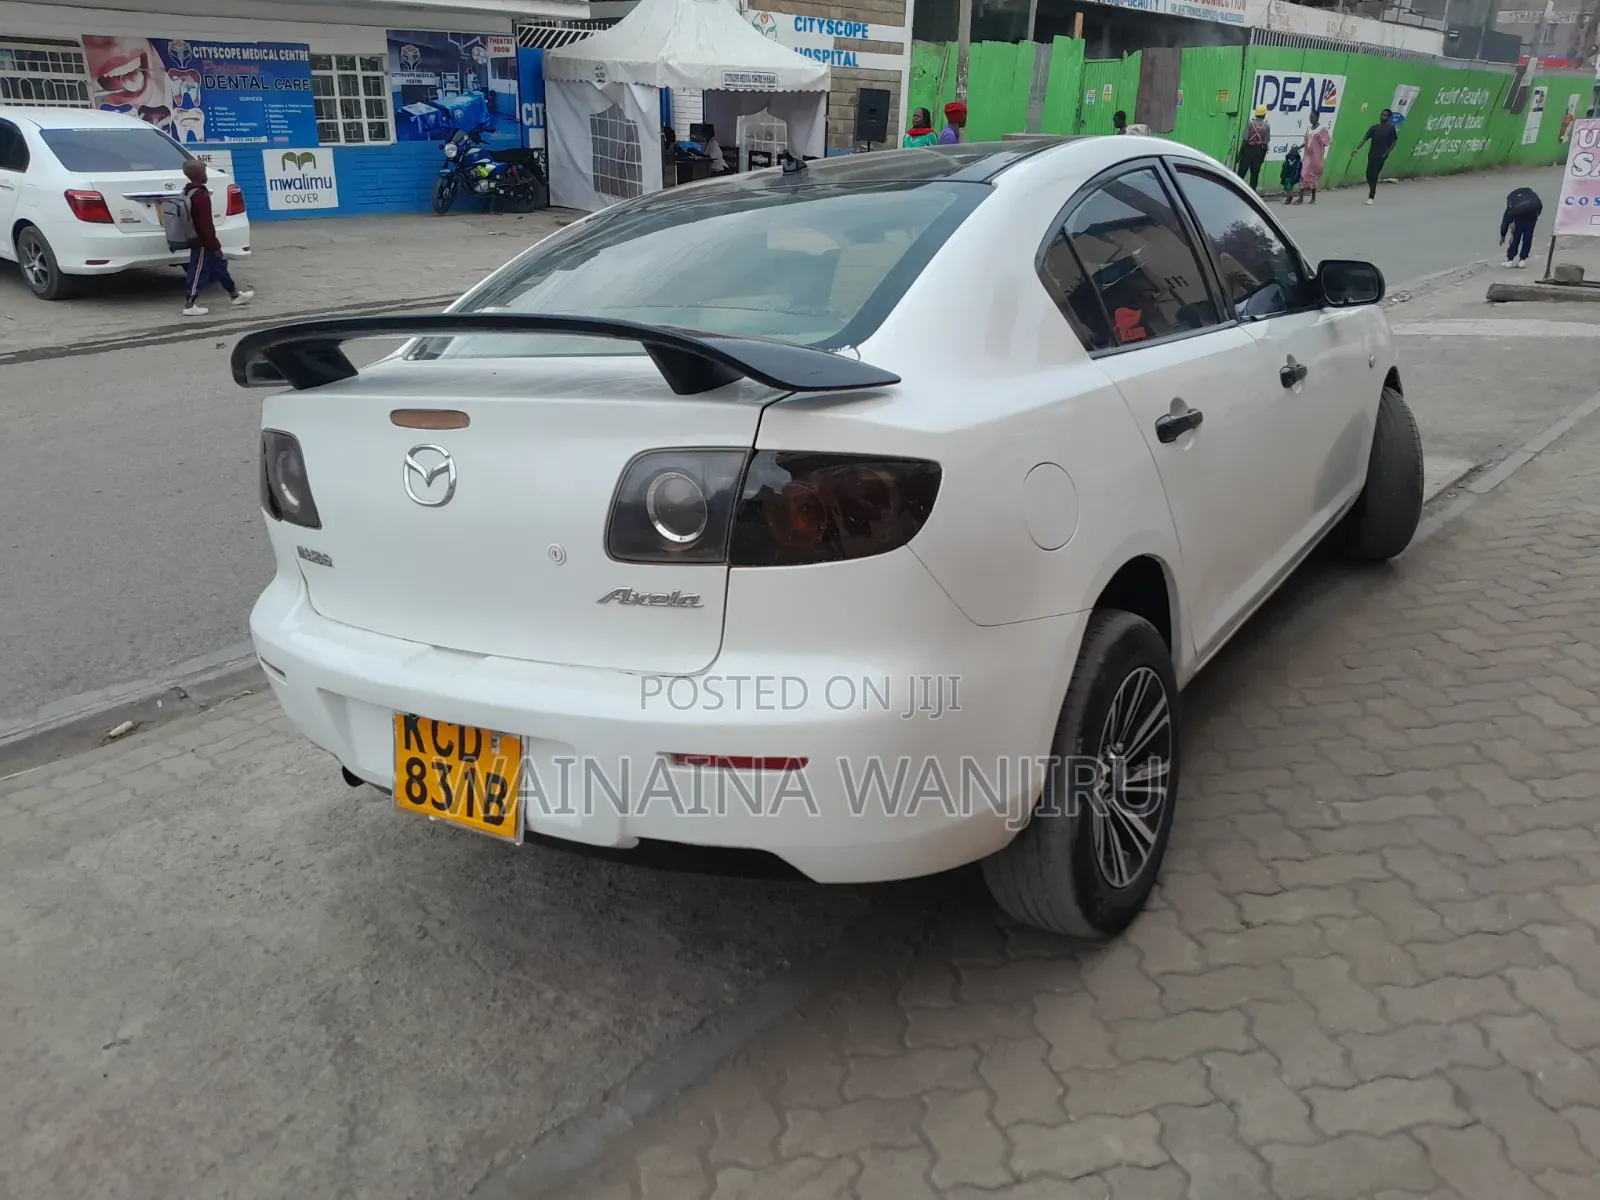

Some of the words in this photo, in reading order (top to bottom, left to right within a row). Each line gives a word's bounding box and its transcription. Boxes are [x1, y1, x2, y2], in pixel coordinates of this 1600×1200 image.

[794, 16, 869, 38] CITYSCOPE
[192, 46, 241, 60] CITYSCOPE
[241, 48, 278, 60] MEDICAL
[280, 49, 309, 61] CENTRE
[203, 74, 271, 91] DENTAL
[274, 78, 311, 91] CARE
[1253, 75, 1336, 113] IDEAL
[1578, 128, 1600, 148] U
[270, 173, 333, 191] mwalimu
[285, 193, 319, 204] COVER
[596, 586, 705, 608] Axela
[403, 713, 482, 762] KCD
[405, 757, 508, 826] 831B
